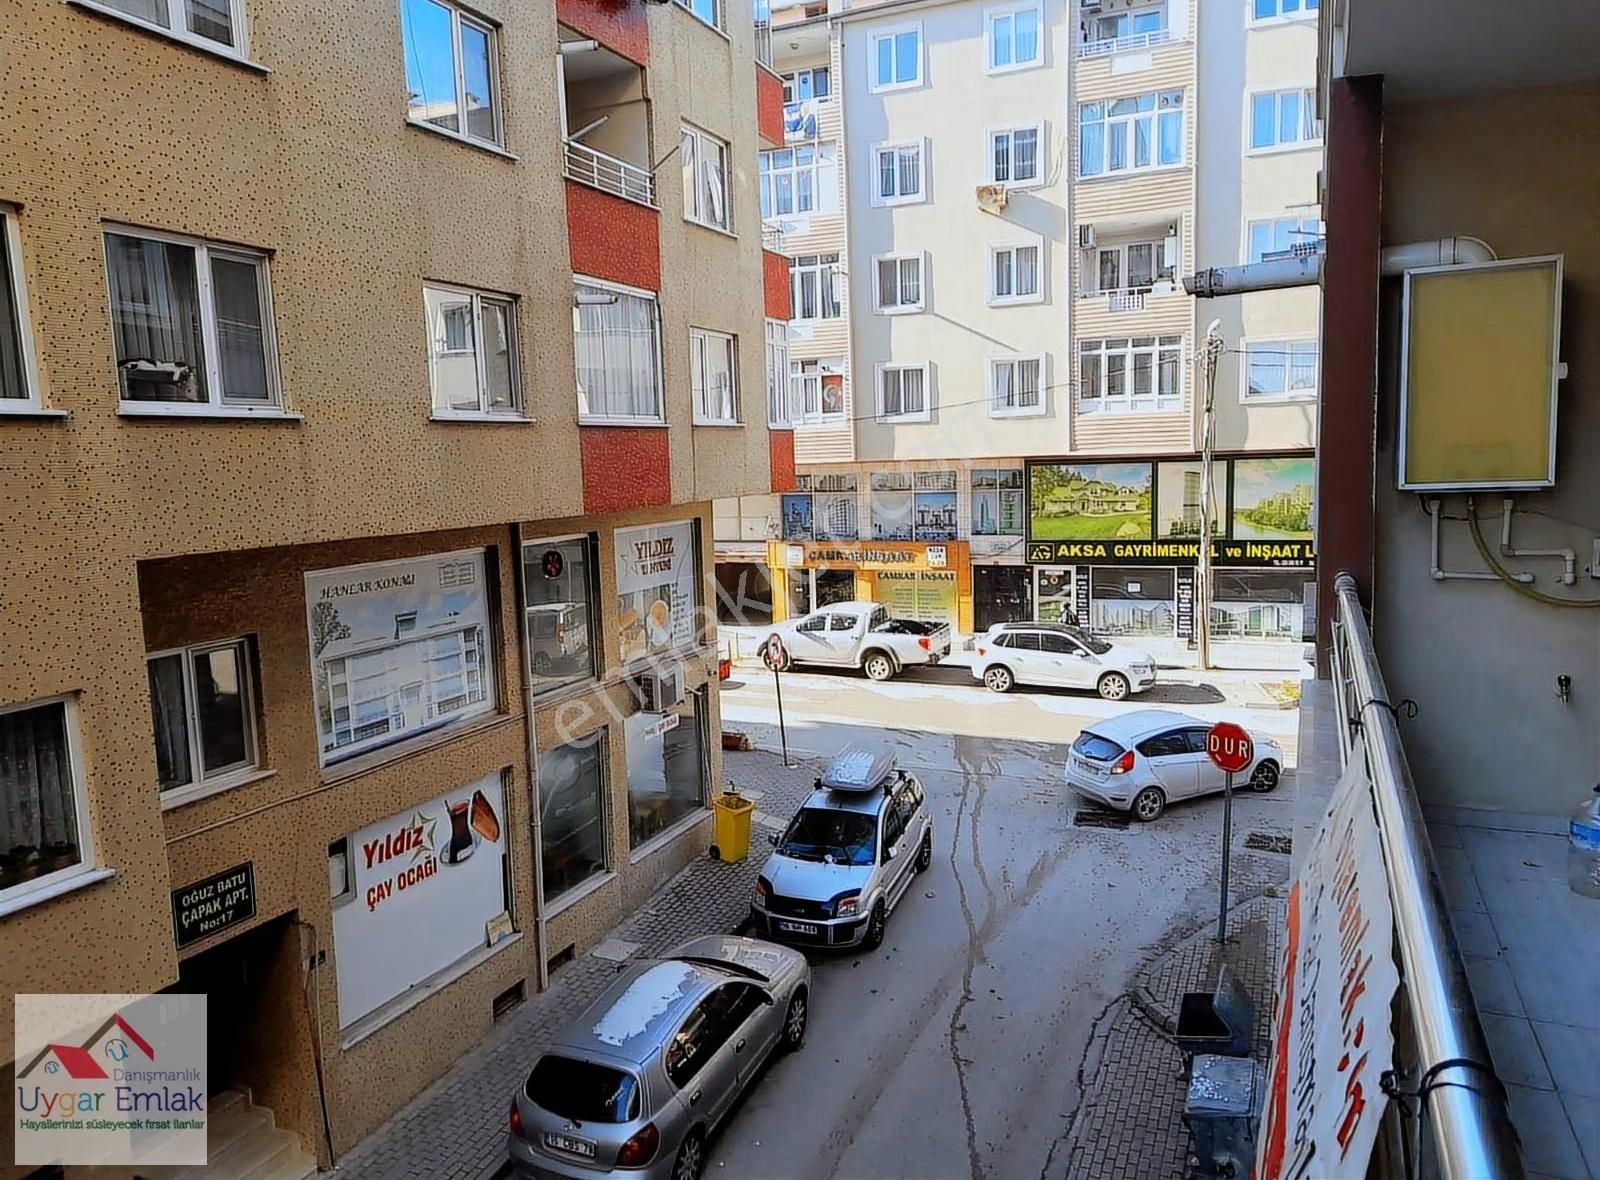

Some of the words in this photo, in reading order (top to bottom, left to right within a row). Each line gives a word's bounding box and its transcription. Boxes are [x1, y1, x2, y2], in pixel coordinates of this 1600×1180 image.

[635, 537, 675, 559] YILDIZ
[1057, 544, 1107, 558] AKSA
[1114, 541, 1219, 558] GAYRİMENKL
[1226, 547, 1241, 558] ve
[1246, 541, 1301, 561] İNŞAAT
[1210, 734, 1249, 759] DUR
[181, 882, 214, 908] OĞUZ
[217, 872, 246, 894] BATU
[366, 879, 393, 911] ÇAY
[397, 854, 438, 892] OCAĞI
[182, 898, 222, 929] ÇAPAK
[224, 888, 249, 911] APT.
[200, 910, 234, 933] No:17
